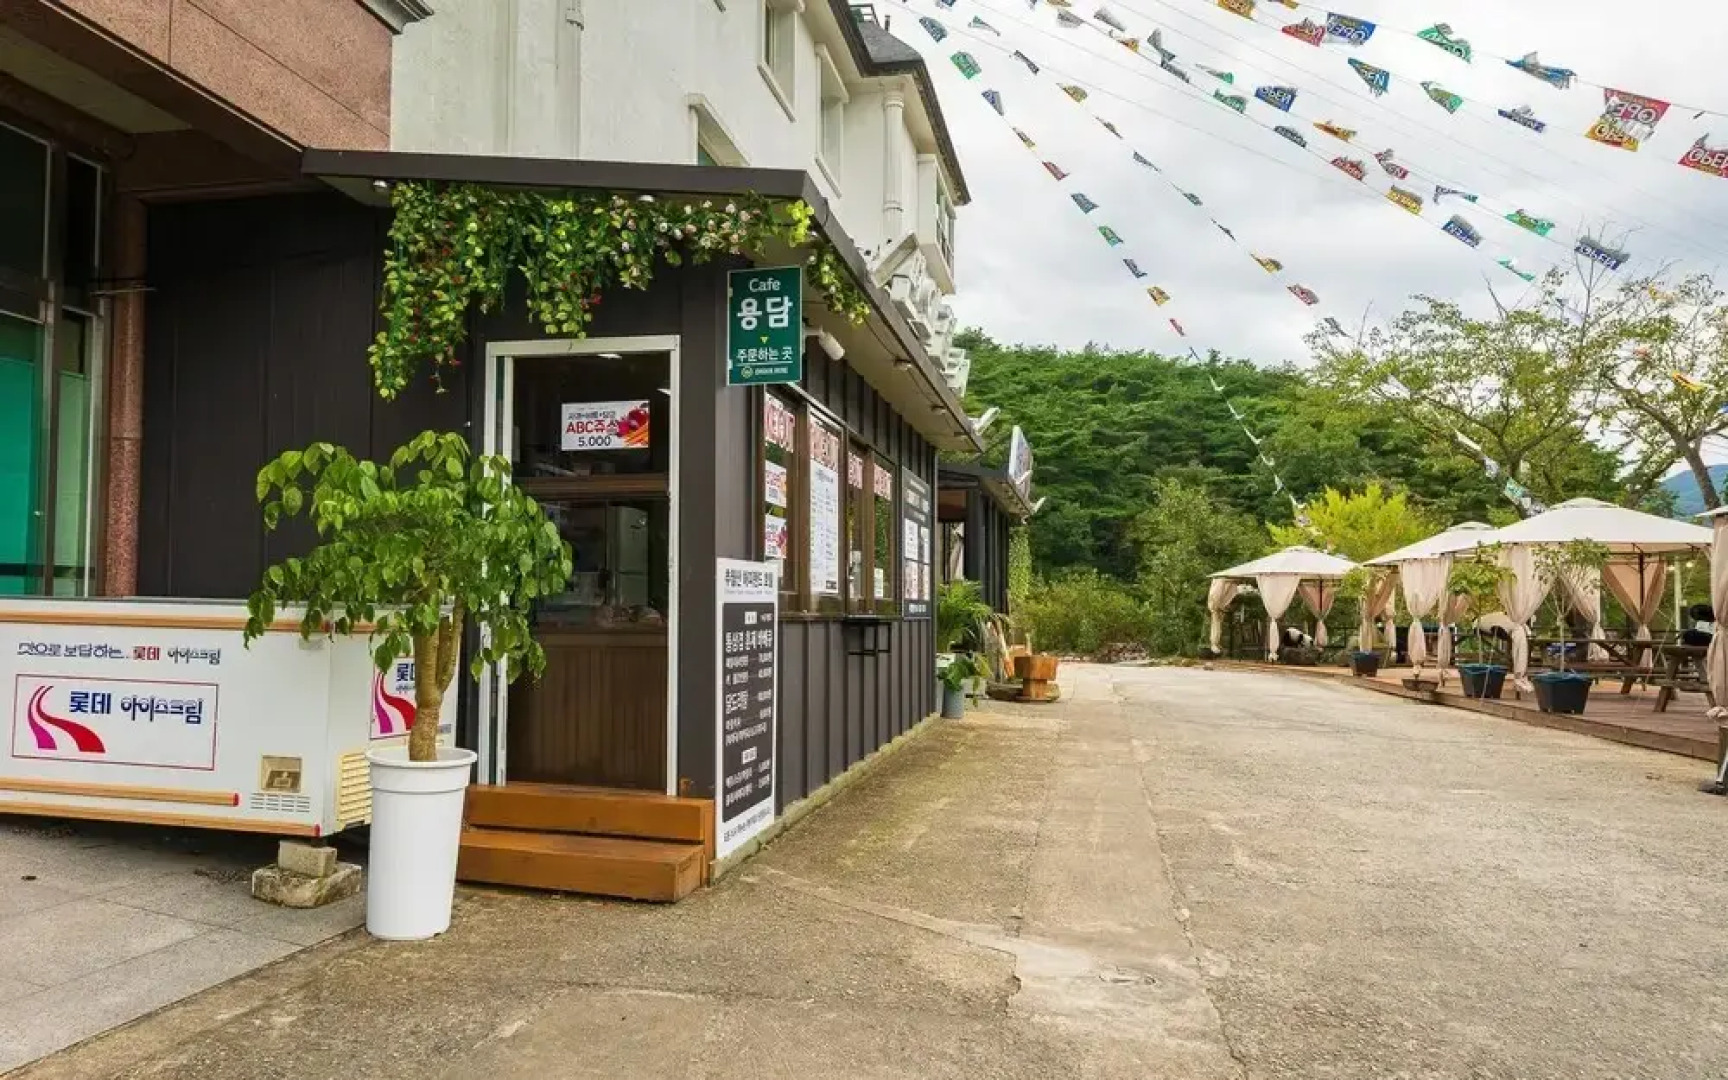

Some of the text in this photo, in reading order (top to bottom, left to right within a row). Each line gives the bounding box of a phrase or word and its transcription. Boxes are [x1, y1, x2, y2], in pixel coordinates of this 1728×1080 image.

[749, 278, 781, 292] Cafe
[737, 295, 793, 331] 용담
[737, 346, 793, 362] 주문하는 곳
[132, 646, 160, 661] 롯데
[167, 648, 221, 666] 아이스크림
[69, 691, 204, 725] 롯데 아이스크림
